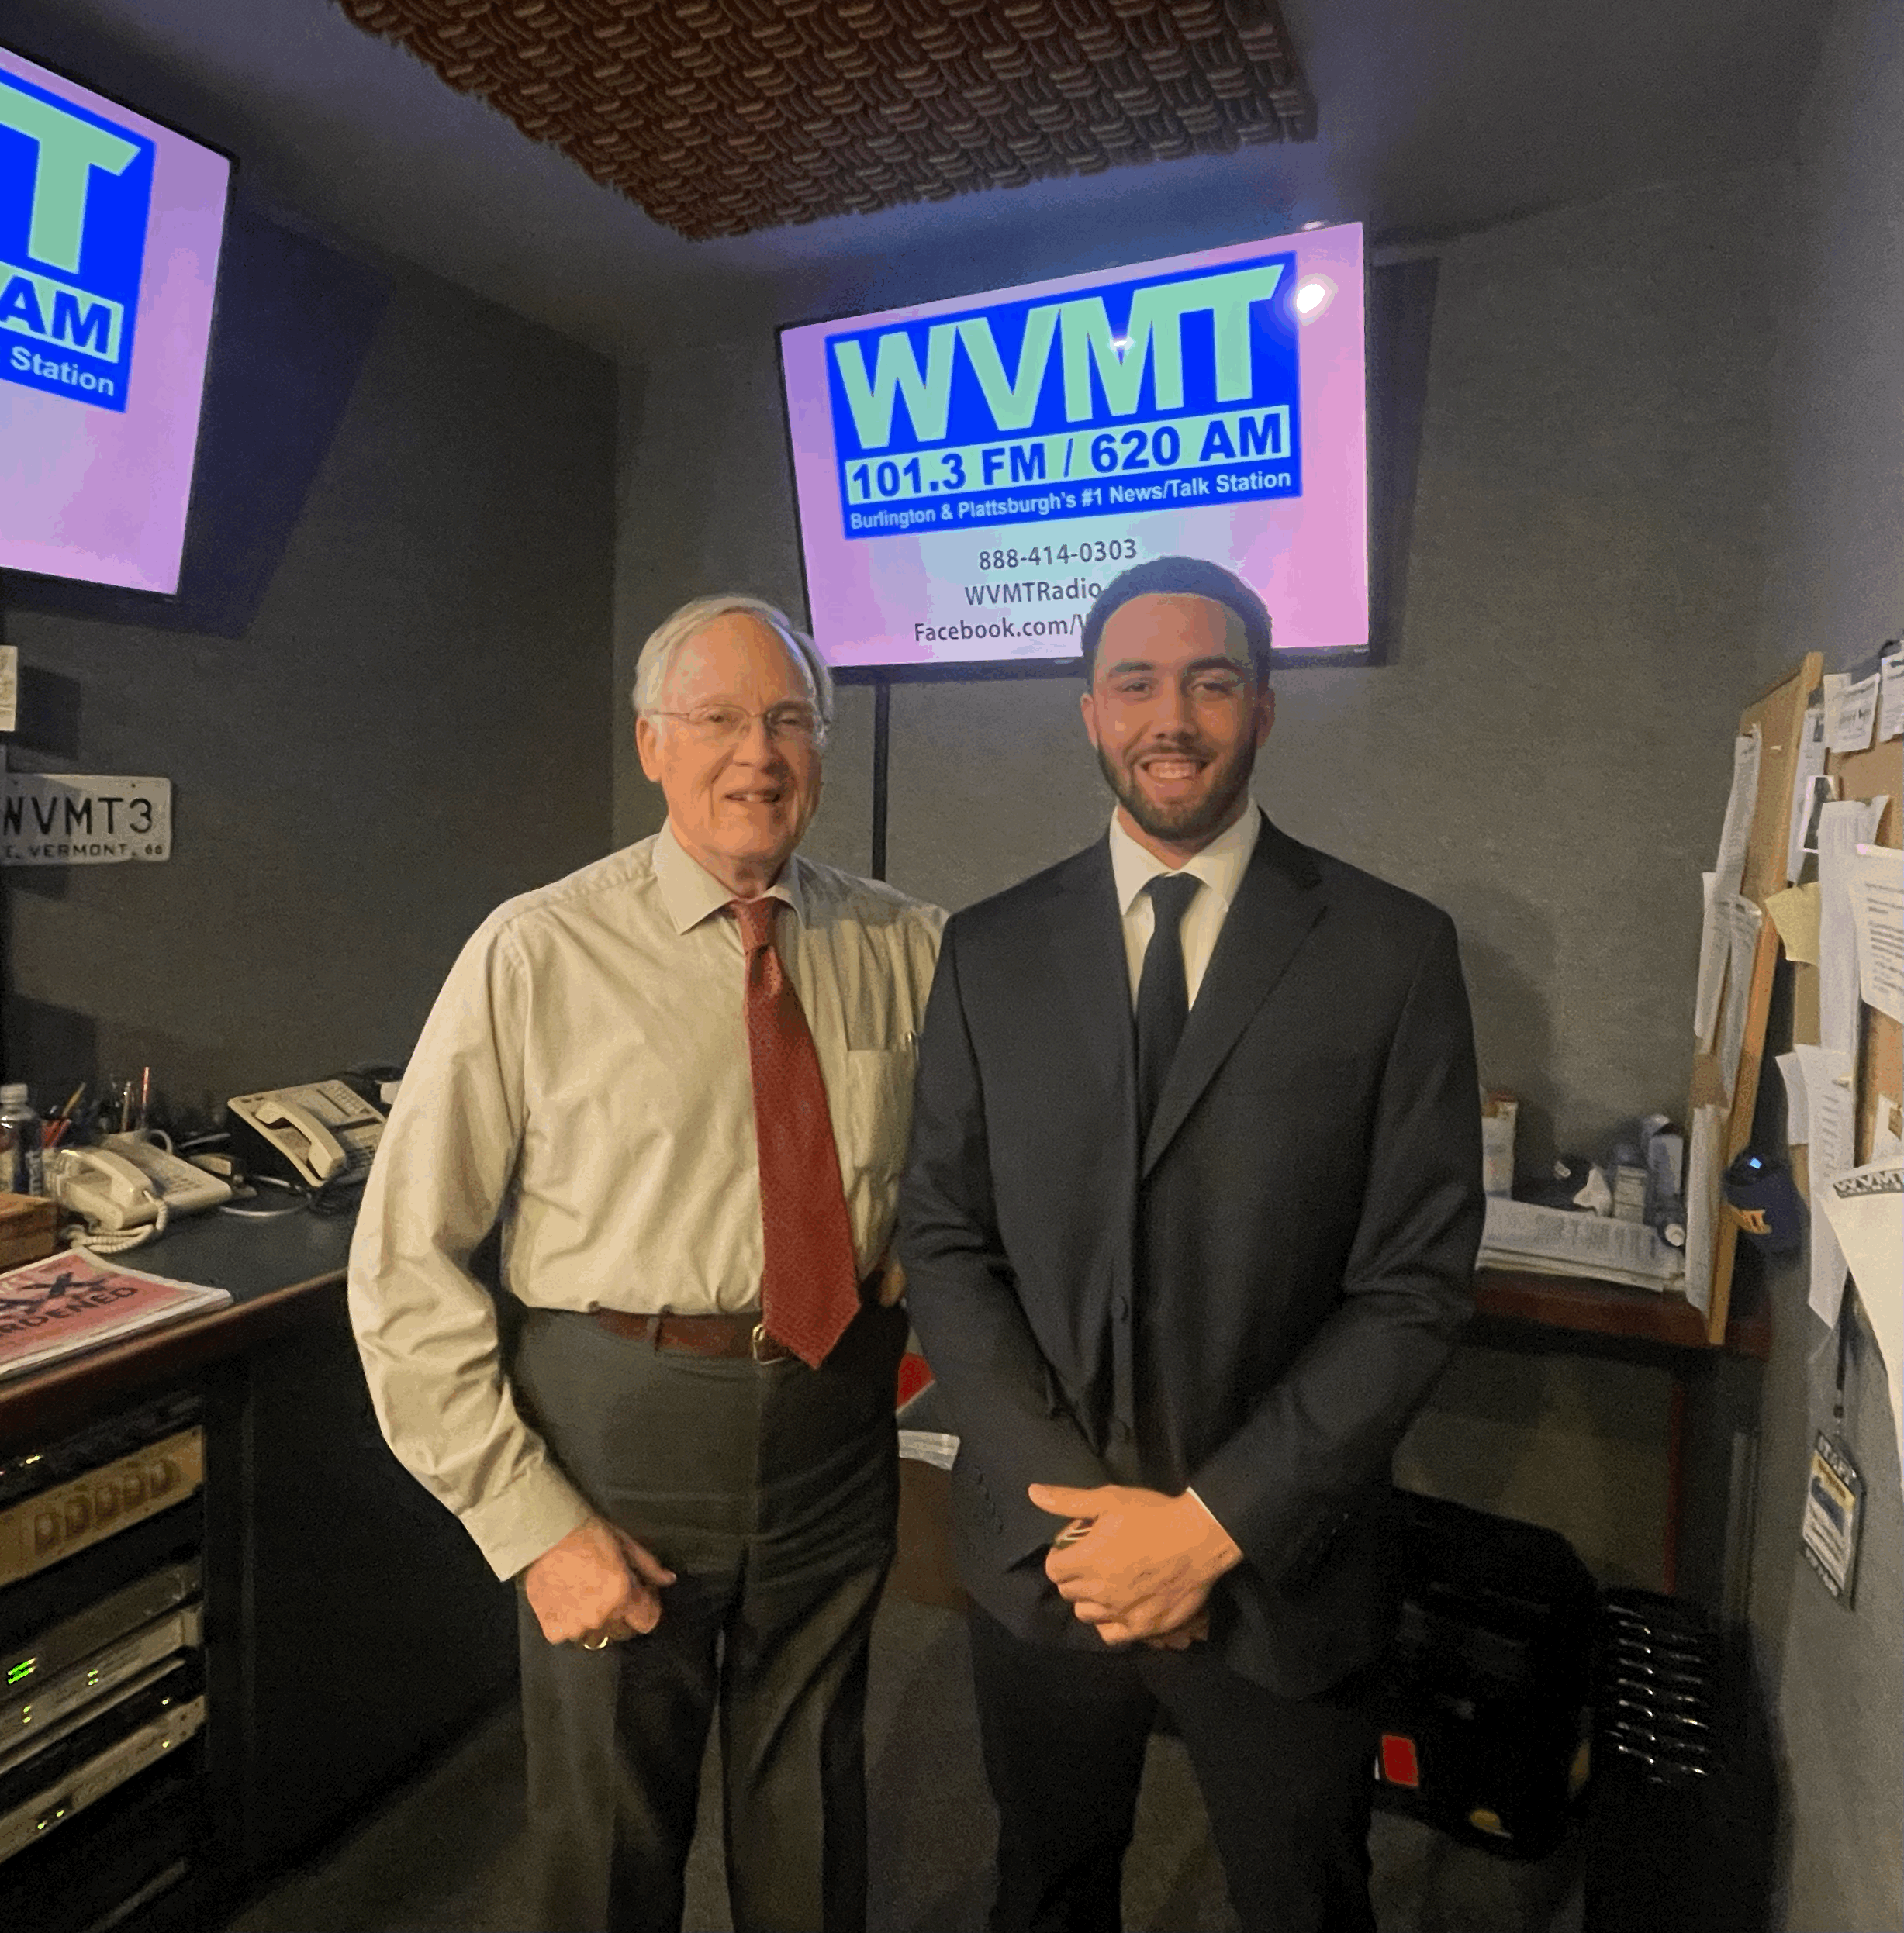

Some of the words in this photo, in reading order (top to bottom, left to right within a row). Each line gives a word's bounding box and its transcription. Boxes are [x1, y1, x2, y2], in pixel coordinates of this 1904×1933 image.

[0, 274, 113, 356] AM
[10, 345, 116, 397] Station
[833, 263, 1286, 450] WVMT
[852, 453, 966, 500] 101.3
[982, 443, 1047, 485] FM
[1063, 437, 1074, 478] /
[1090, 426, 1180, 474] 620
[1198, 412, 1283, 461] AM
[850, 509, 936, 530] Burlington
[940, 503, 954, 520] &
[959, 492, 1076, 519] Plattsburgh's
[1081, 487, 1103, 507] #1
[1110, 477, 1210, 504] News/Talk
[1216, 471, 1291, 493] Station
[979, 538, 1138, 571] 888-414-0303
[28, 843, 128, 858] VERMONT
